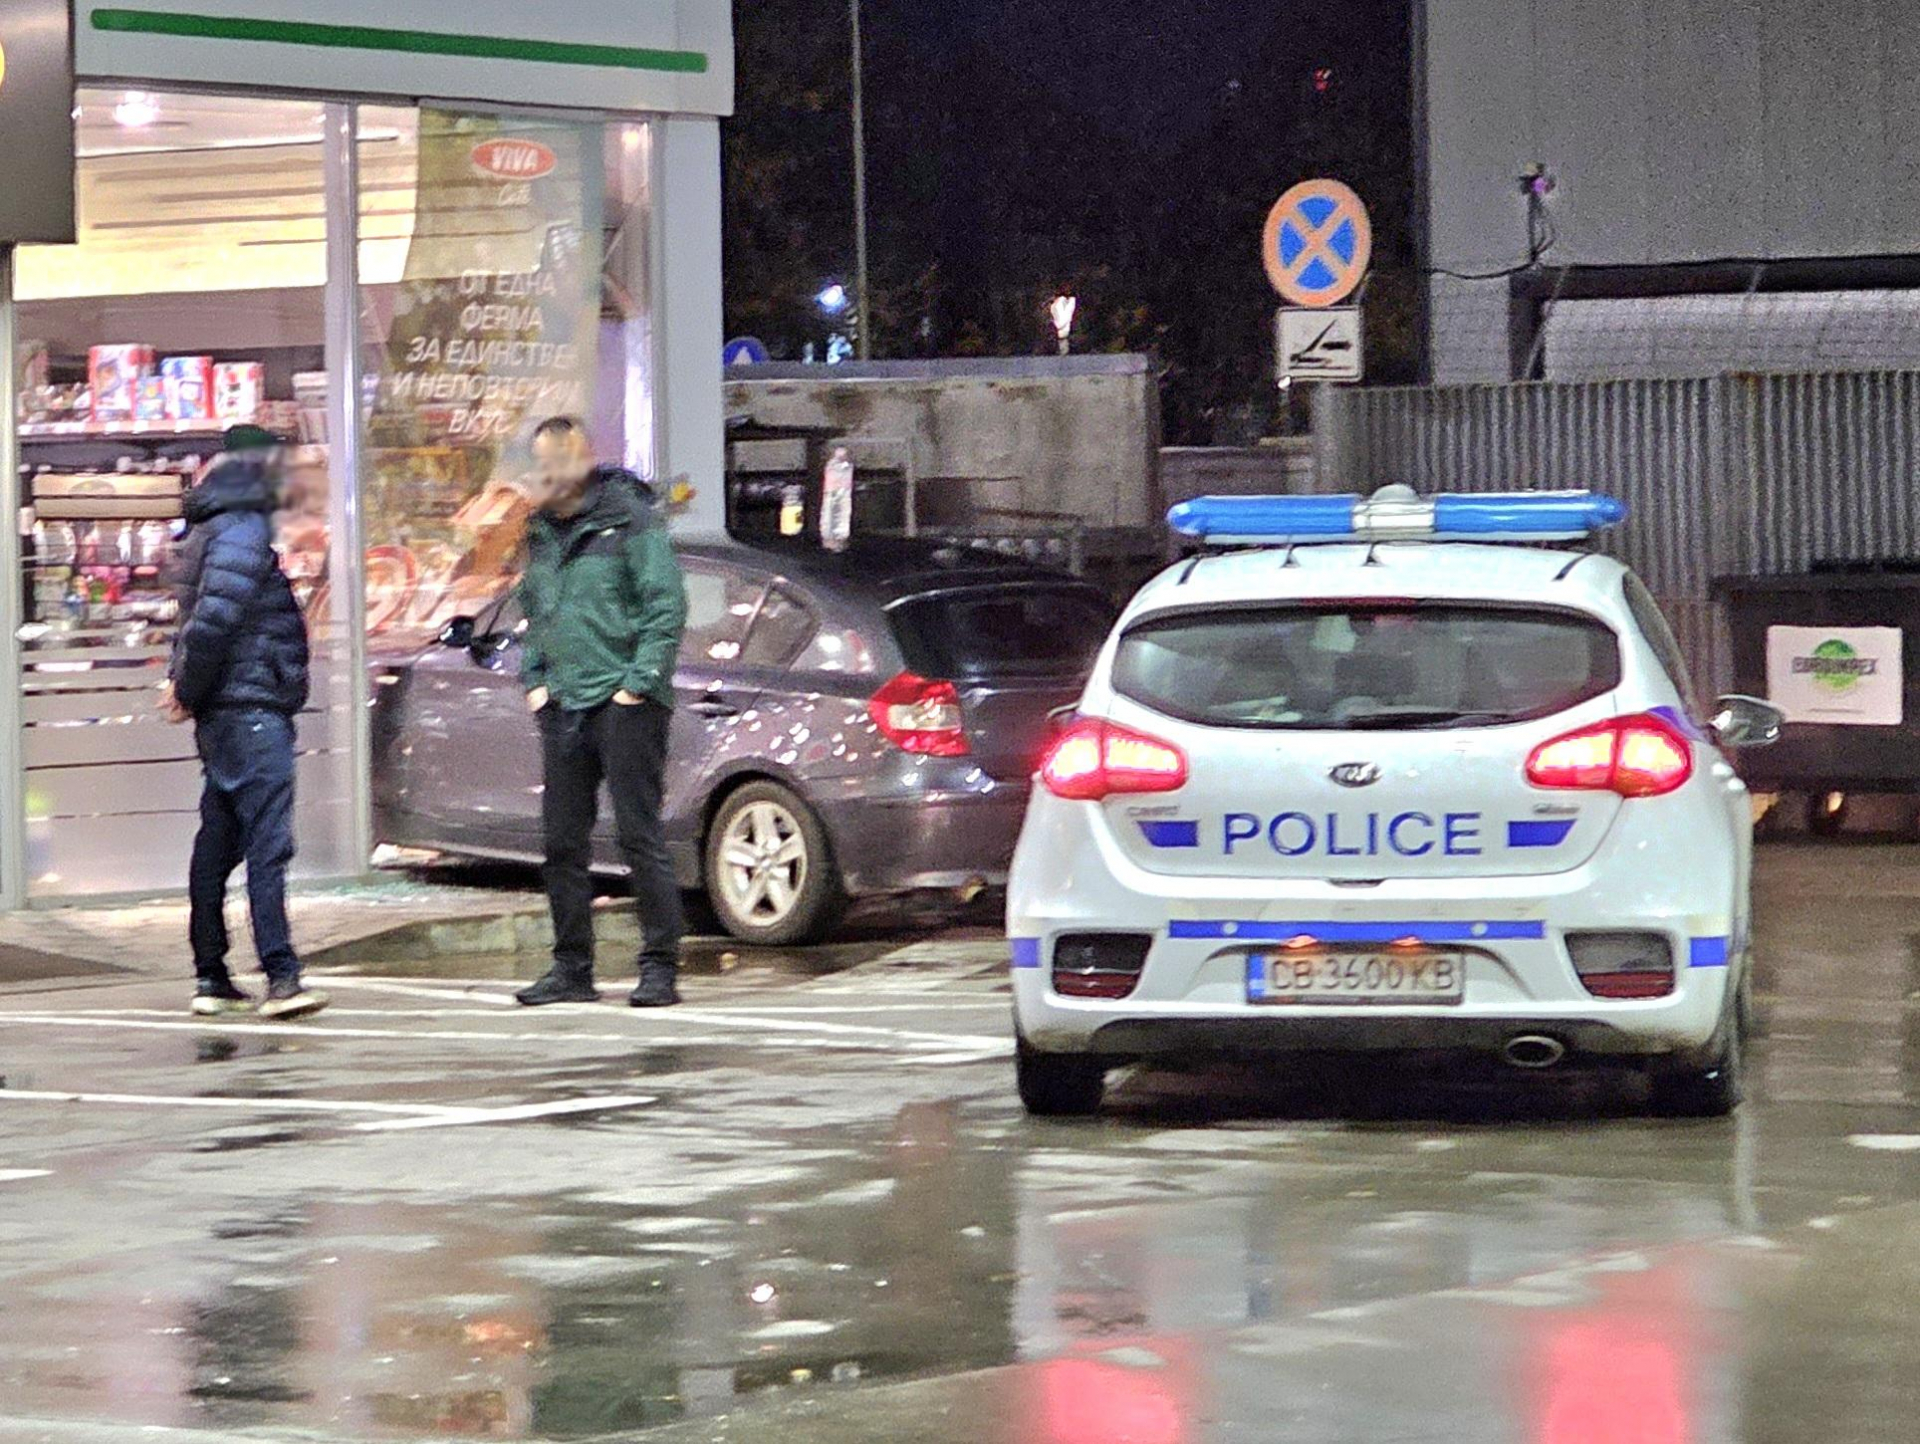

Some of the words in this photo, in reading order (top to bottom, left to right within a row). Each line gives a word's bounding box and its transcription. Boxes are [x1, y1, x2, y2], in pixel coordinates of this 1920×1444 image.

[491, 145, 538, 172] VIVA
[494, 271, 557, 297] ЕДНА
[460, 302, 543, 332] ФЕРМА
[406, 336, 440, 364] ЗА
[391, 371, 413, 397] И
[448, 408, 521, 446] ВКУС
[1222, 811, 1482, 856] POLICE
